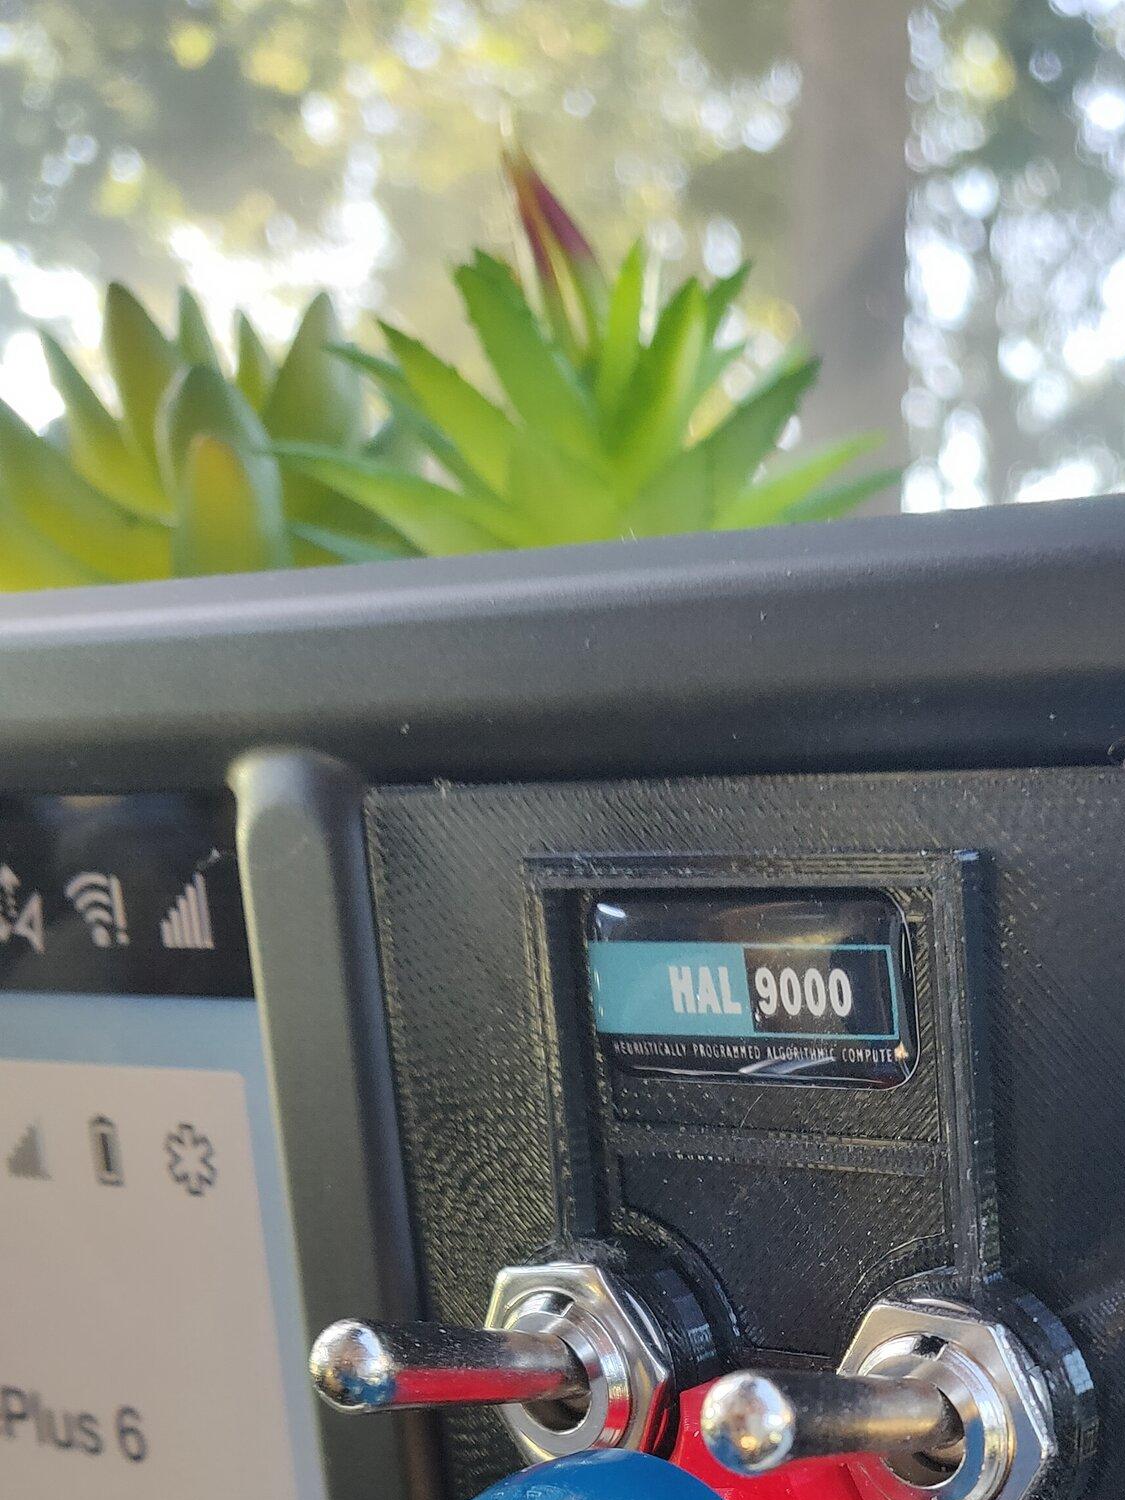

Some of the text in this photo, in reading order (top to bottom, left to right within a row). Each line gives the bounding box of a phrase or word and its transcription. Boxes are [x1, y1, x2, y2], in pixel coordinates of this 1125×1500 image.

[668, 965, 852, 1017] HAL 9000
[614, 1040, 688, 1057] HEURISTICALLY
[692, 1043, 760, 1060] PROGRAMMED
[766, 1045, 835, 1061] ALGORITHMIC
[115, 1405, 148, 1464] 6
